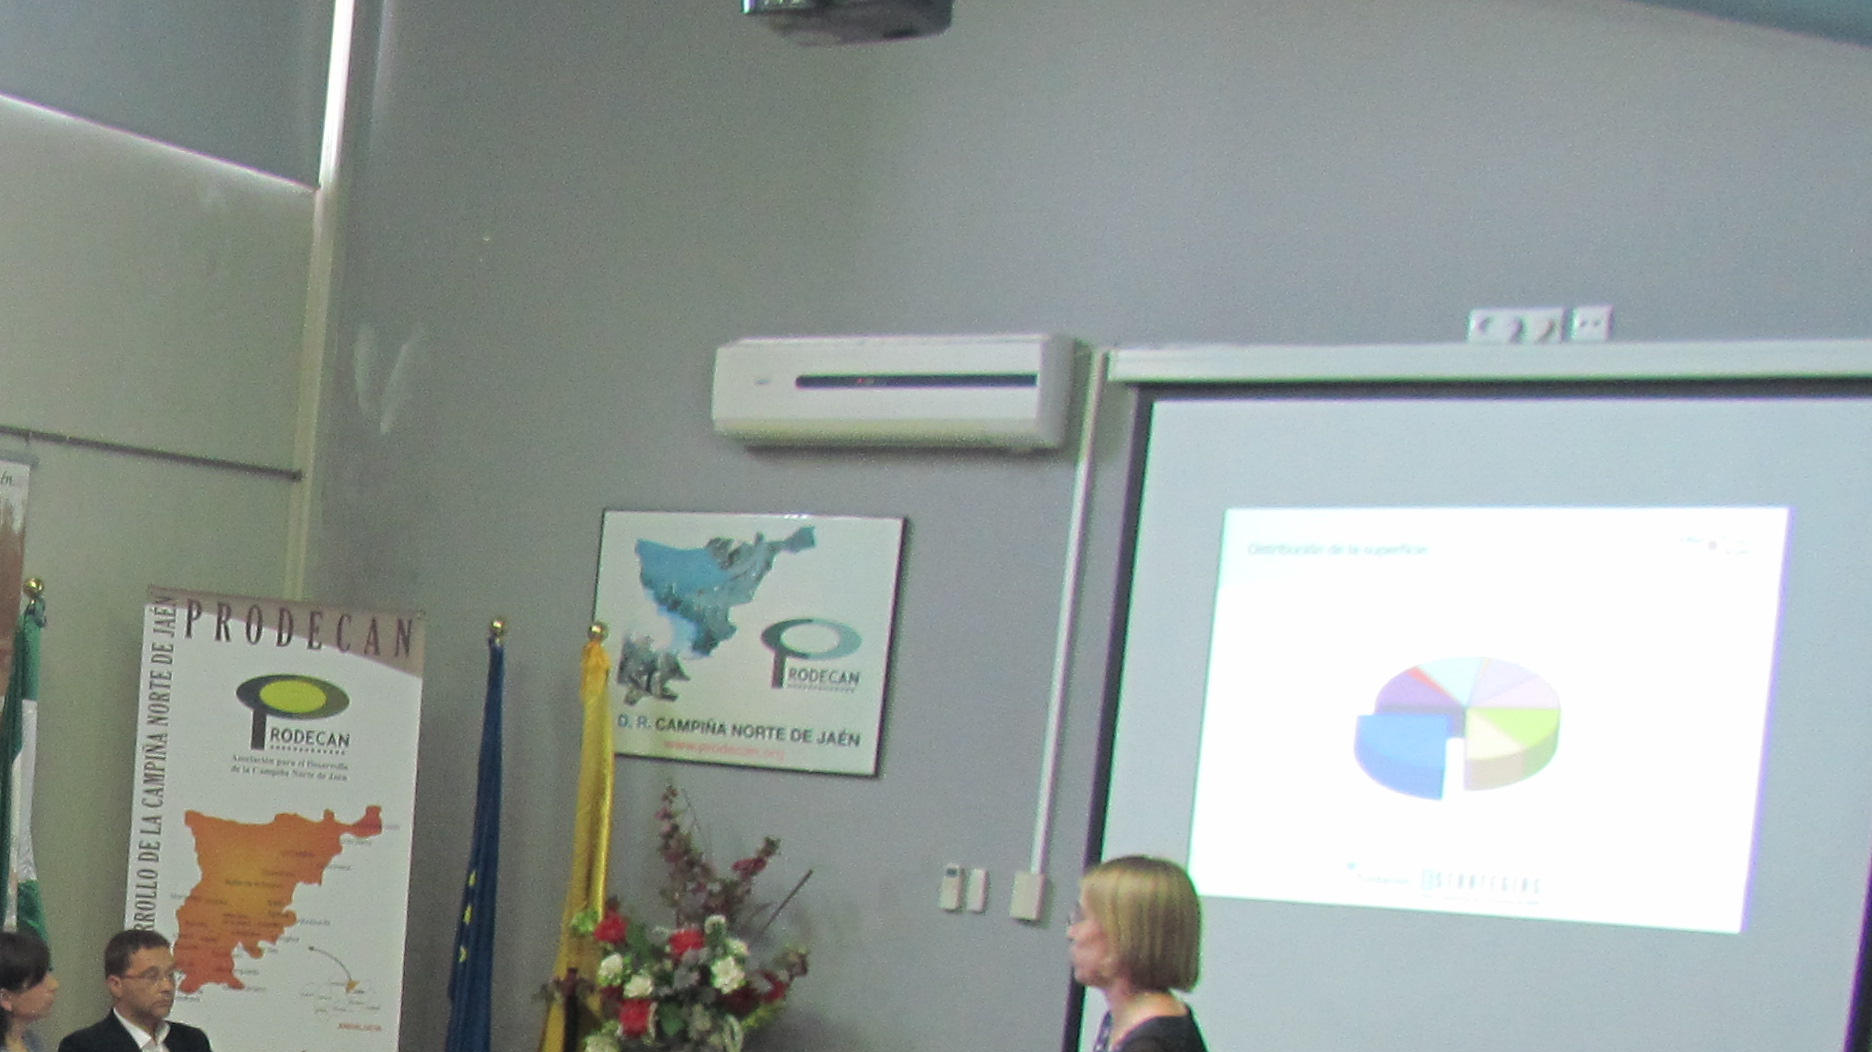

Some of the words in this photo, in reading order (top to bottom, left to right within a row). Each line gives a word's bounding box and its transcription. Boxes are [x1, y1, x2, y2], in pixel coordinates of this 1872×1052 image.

[184, 598, 414, 658] PRODECAN
[151, 641, 174, 664] DE
[147, 670, 172, 727] NORTE
[656, 716, 726, 736] CAMPIÑA
[730, 724, 785, 741] NORTE
[790, 728, 813, 743] DE
[816, 727, 861, 747] JAÉN
[141, 733, 168, 808] CAMPIÑA
[140, 814, 163, 835] LA
[138, 840, 160, 862] DE
